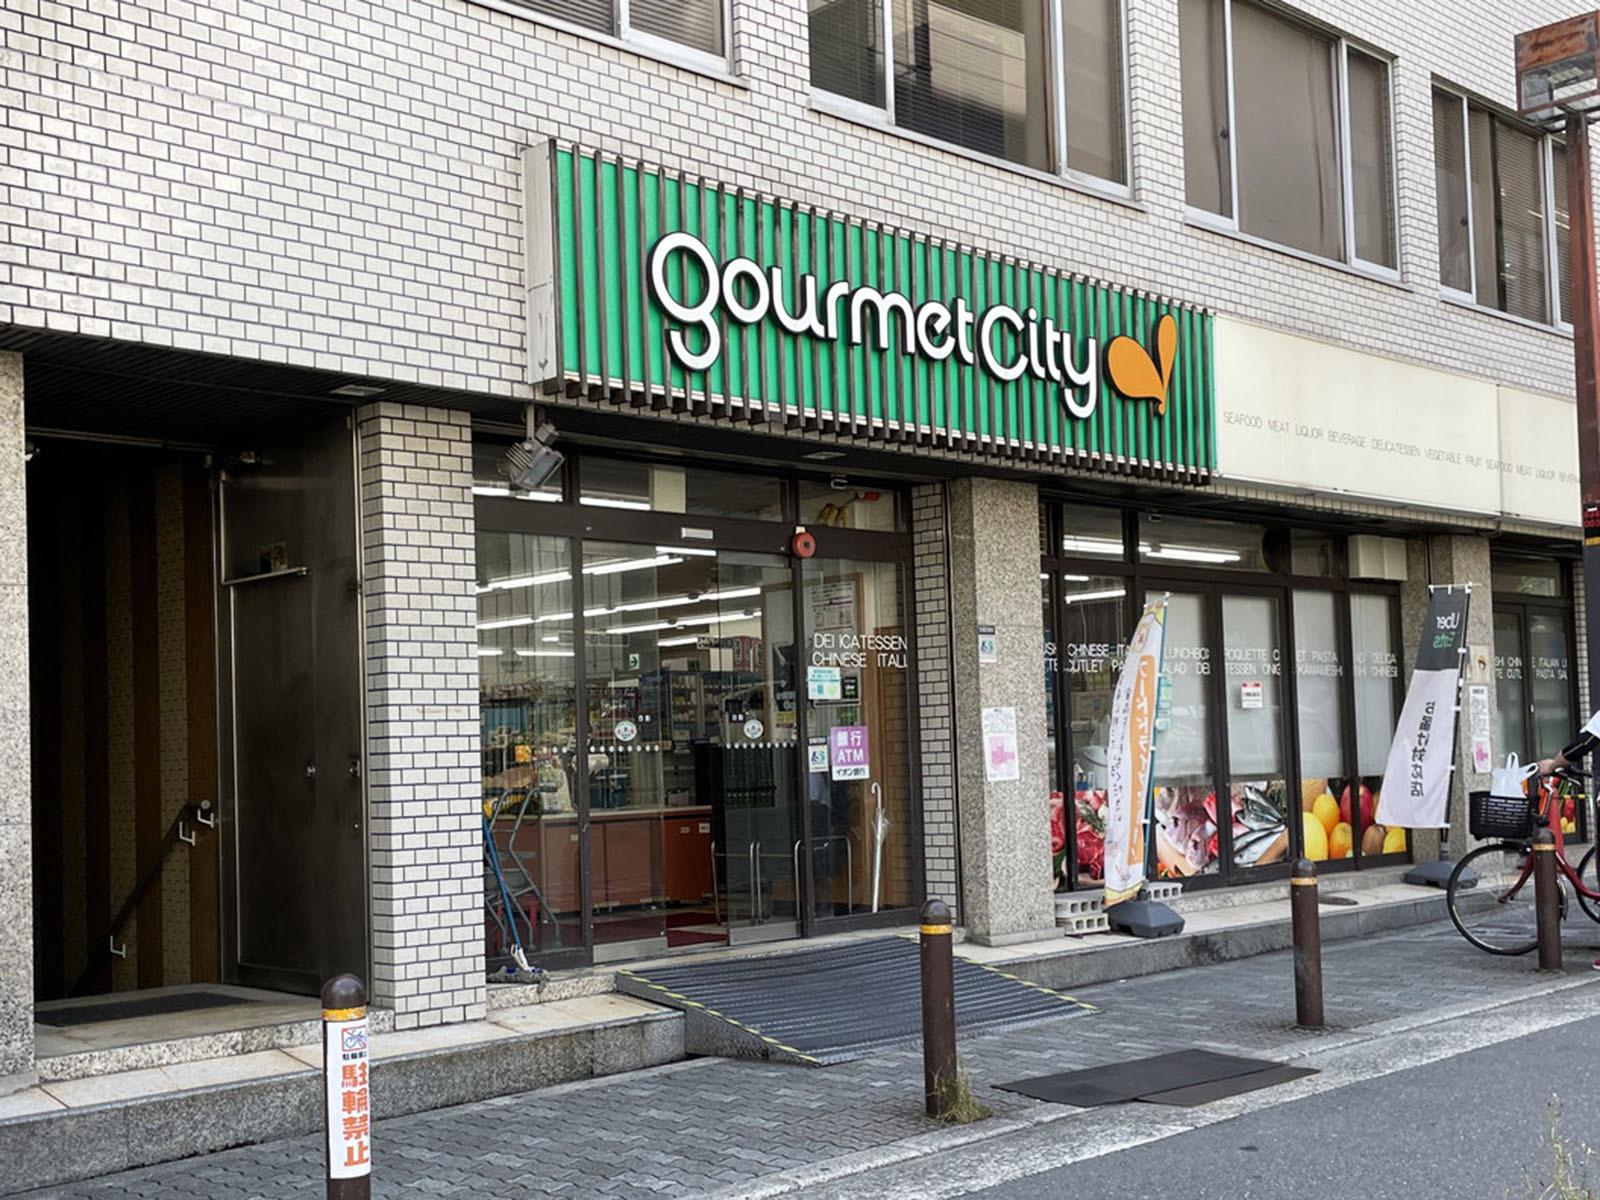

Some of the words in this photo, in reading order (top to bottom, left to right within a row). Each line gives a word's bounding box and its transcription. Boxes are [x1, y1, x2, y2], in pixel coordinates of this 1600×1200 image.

[1223, 411, 1263, 429] SEAFOOD
[1268, 419, 1290, 433] MEAT
[1295, 424, 1324, 439] LIQUOR
[1328, 430, 1367, 448] BEVERAGE
[1371, 438, 1421, 457] DELICATESSEN
[1425, 448, 1461, 464] VEGETABLE
[1465, 455, 1482, 468] FRUIT
[1485, 458, 1513, 473] SEAFOOD
[1516, 464, 1532, 476] MEAT
[1536, 469, 1556, 480] LIQUOR
[1067, 643, 1109, 657] CHINESE
[1312, 651, 1338, 663] PASTA
[812, 652, 868, 668] CHINESE
[1536, 668, 1555, 680] PASTA
[837, 730, 862, 747] 銀行
[837, 748, 864, 763] ATM
[836, 768, 866, 777] イオン銀行
[341, 1062, 369, 1167] 駐輪禁止
